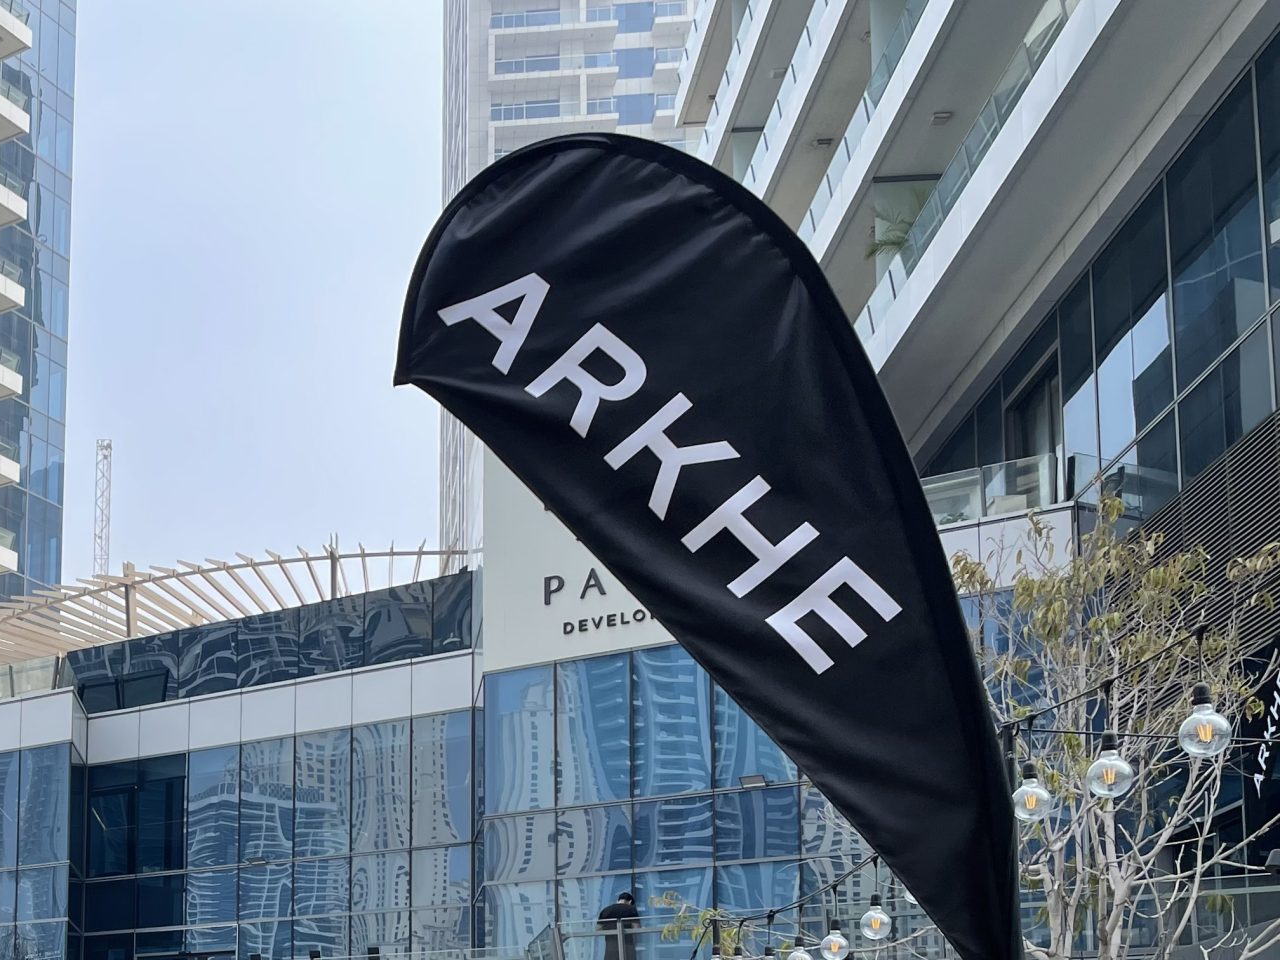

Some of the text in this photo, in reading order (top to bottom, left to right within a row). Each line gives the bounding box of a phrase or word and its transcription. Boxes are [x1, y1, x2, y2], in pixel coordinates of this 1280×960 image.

[437, 272, 902, 675] ARKHE
[544, 567, 606, 606] PA
[562, 608, 655, 635] DEVELO
[1254, 668, 1280, 799] ARKH
